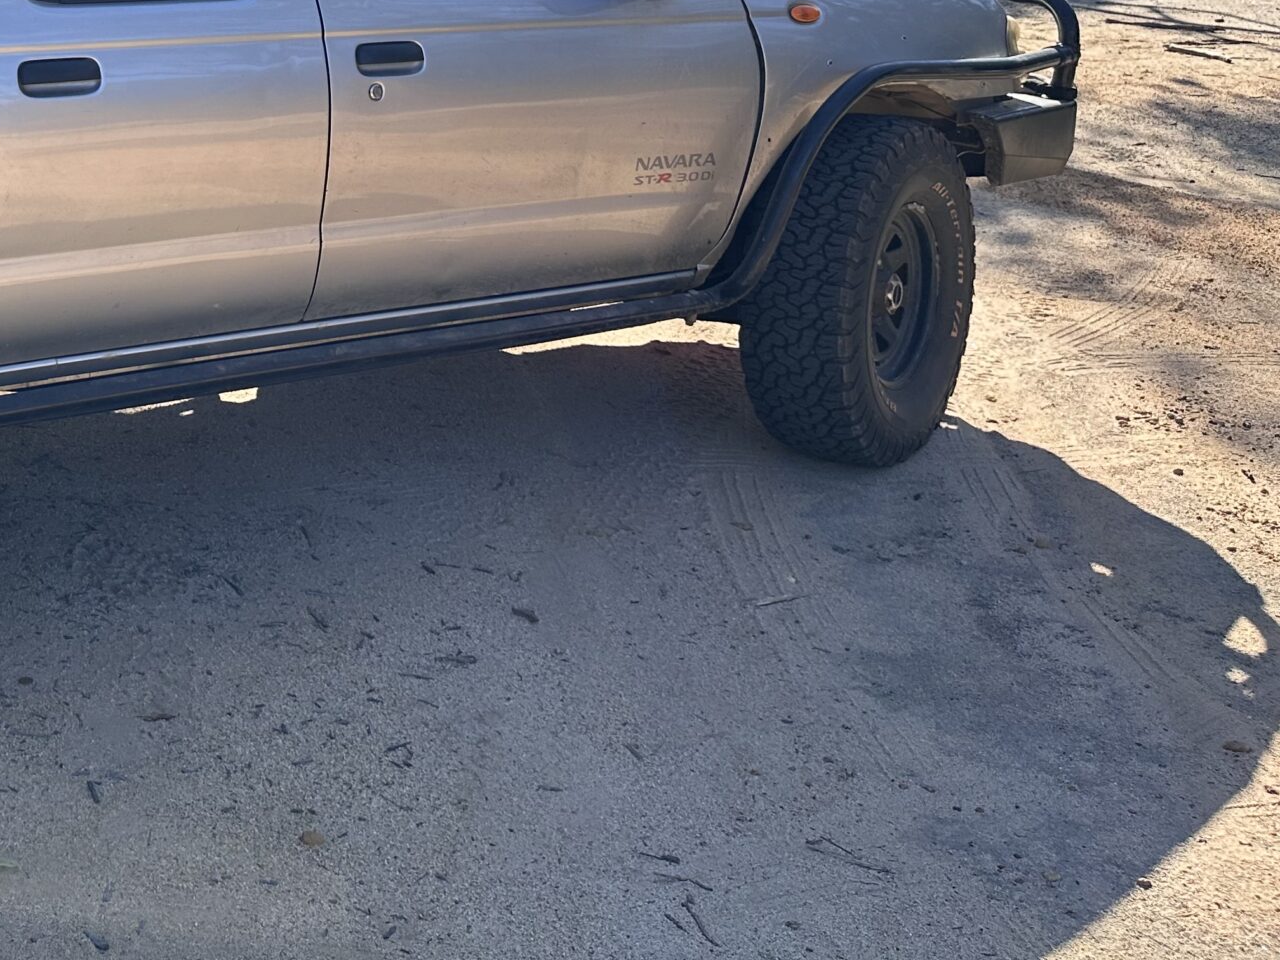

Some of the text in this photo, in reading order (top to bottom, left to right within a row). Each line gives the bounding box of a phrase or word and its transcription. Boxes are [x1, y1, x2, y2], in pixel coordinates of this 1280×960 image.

[635, 152, 716, 171] NAVARA
[633, 173, 672, 185] ST-R
[951, 299, 963, 338] T/A
